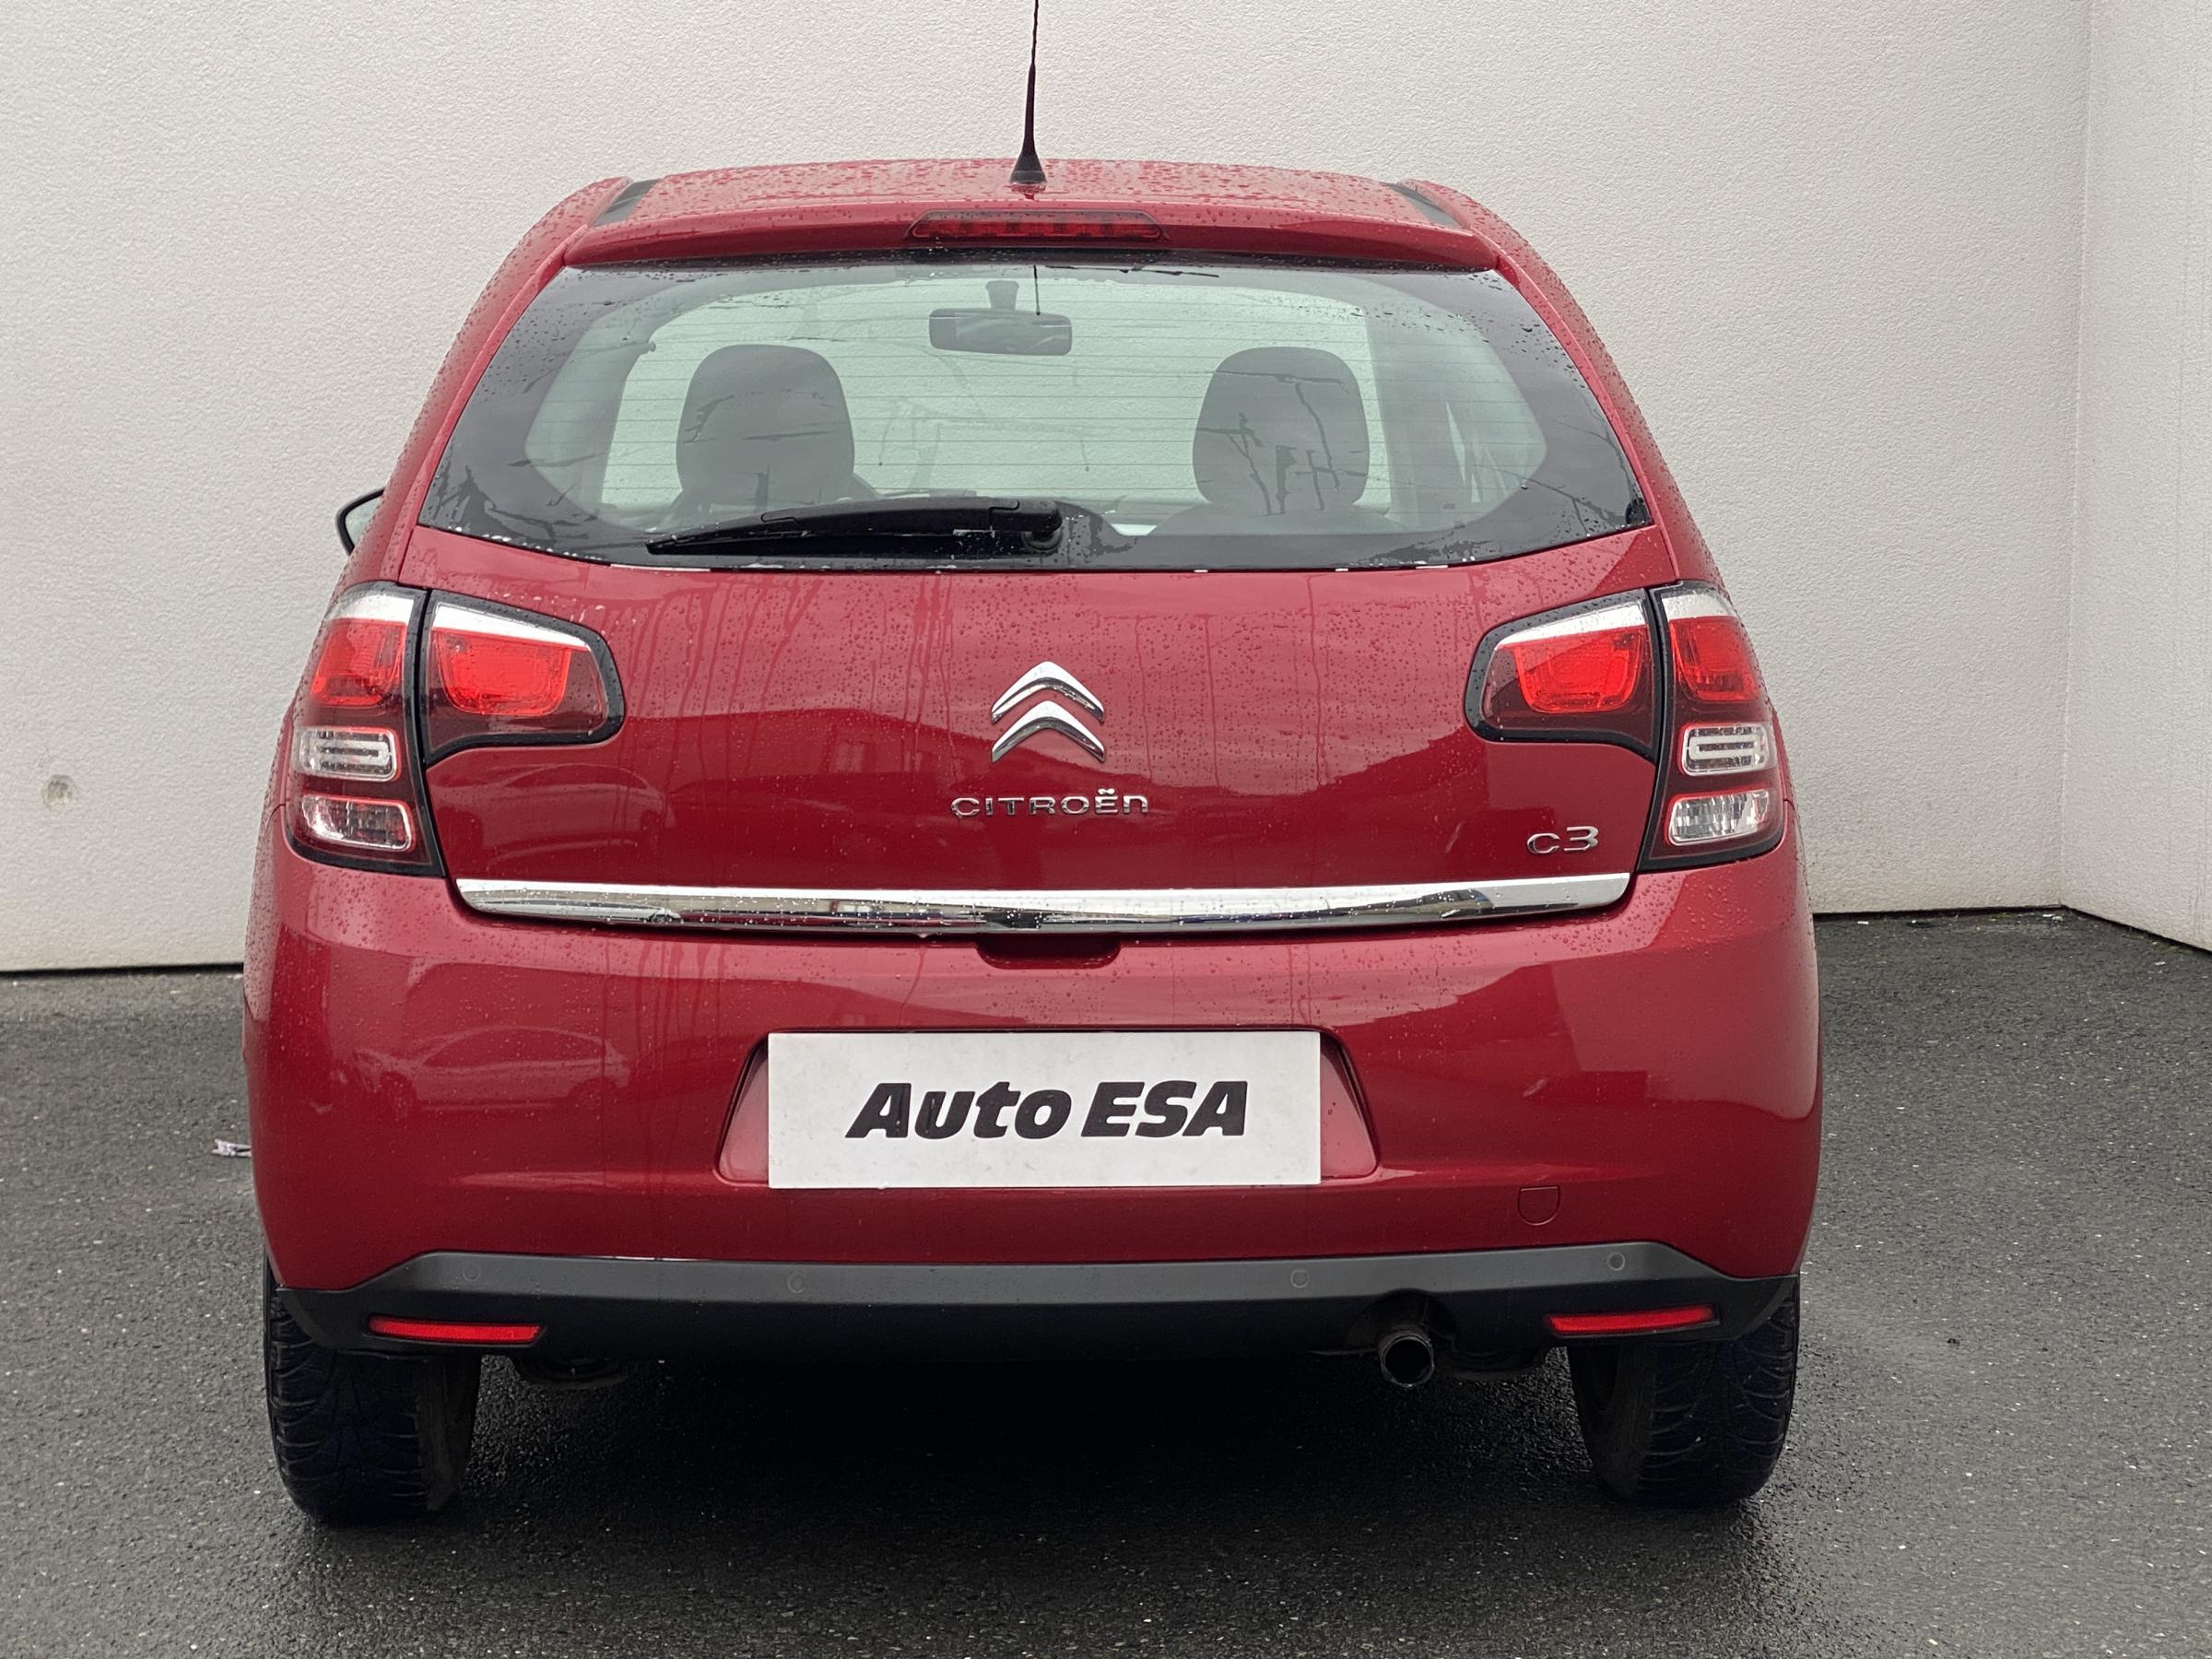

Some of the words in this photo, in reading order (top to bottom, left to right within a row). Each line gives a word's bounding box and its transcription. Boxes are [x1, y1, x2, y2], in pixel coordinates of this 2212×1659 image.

[1526, 825, 1600, 854] C3
[845, 1081, 1072, 1140] Auto
[1080, 1080, 1249, 1138] ESA
